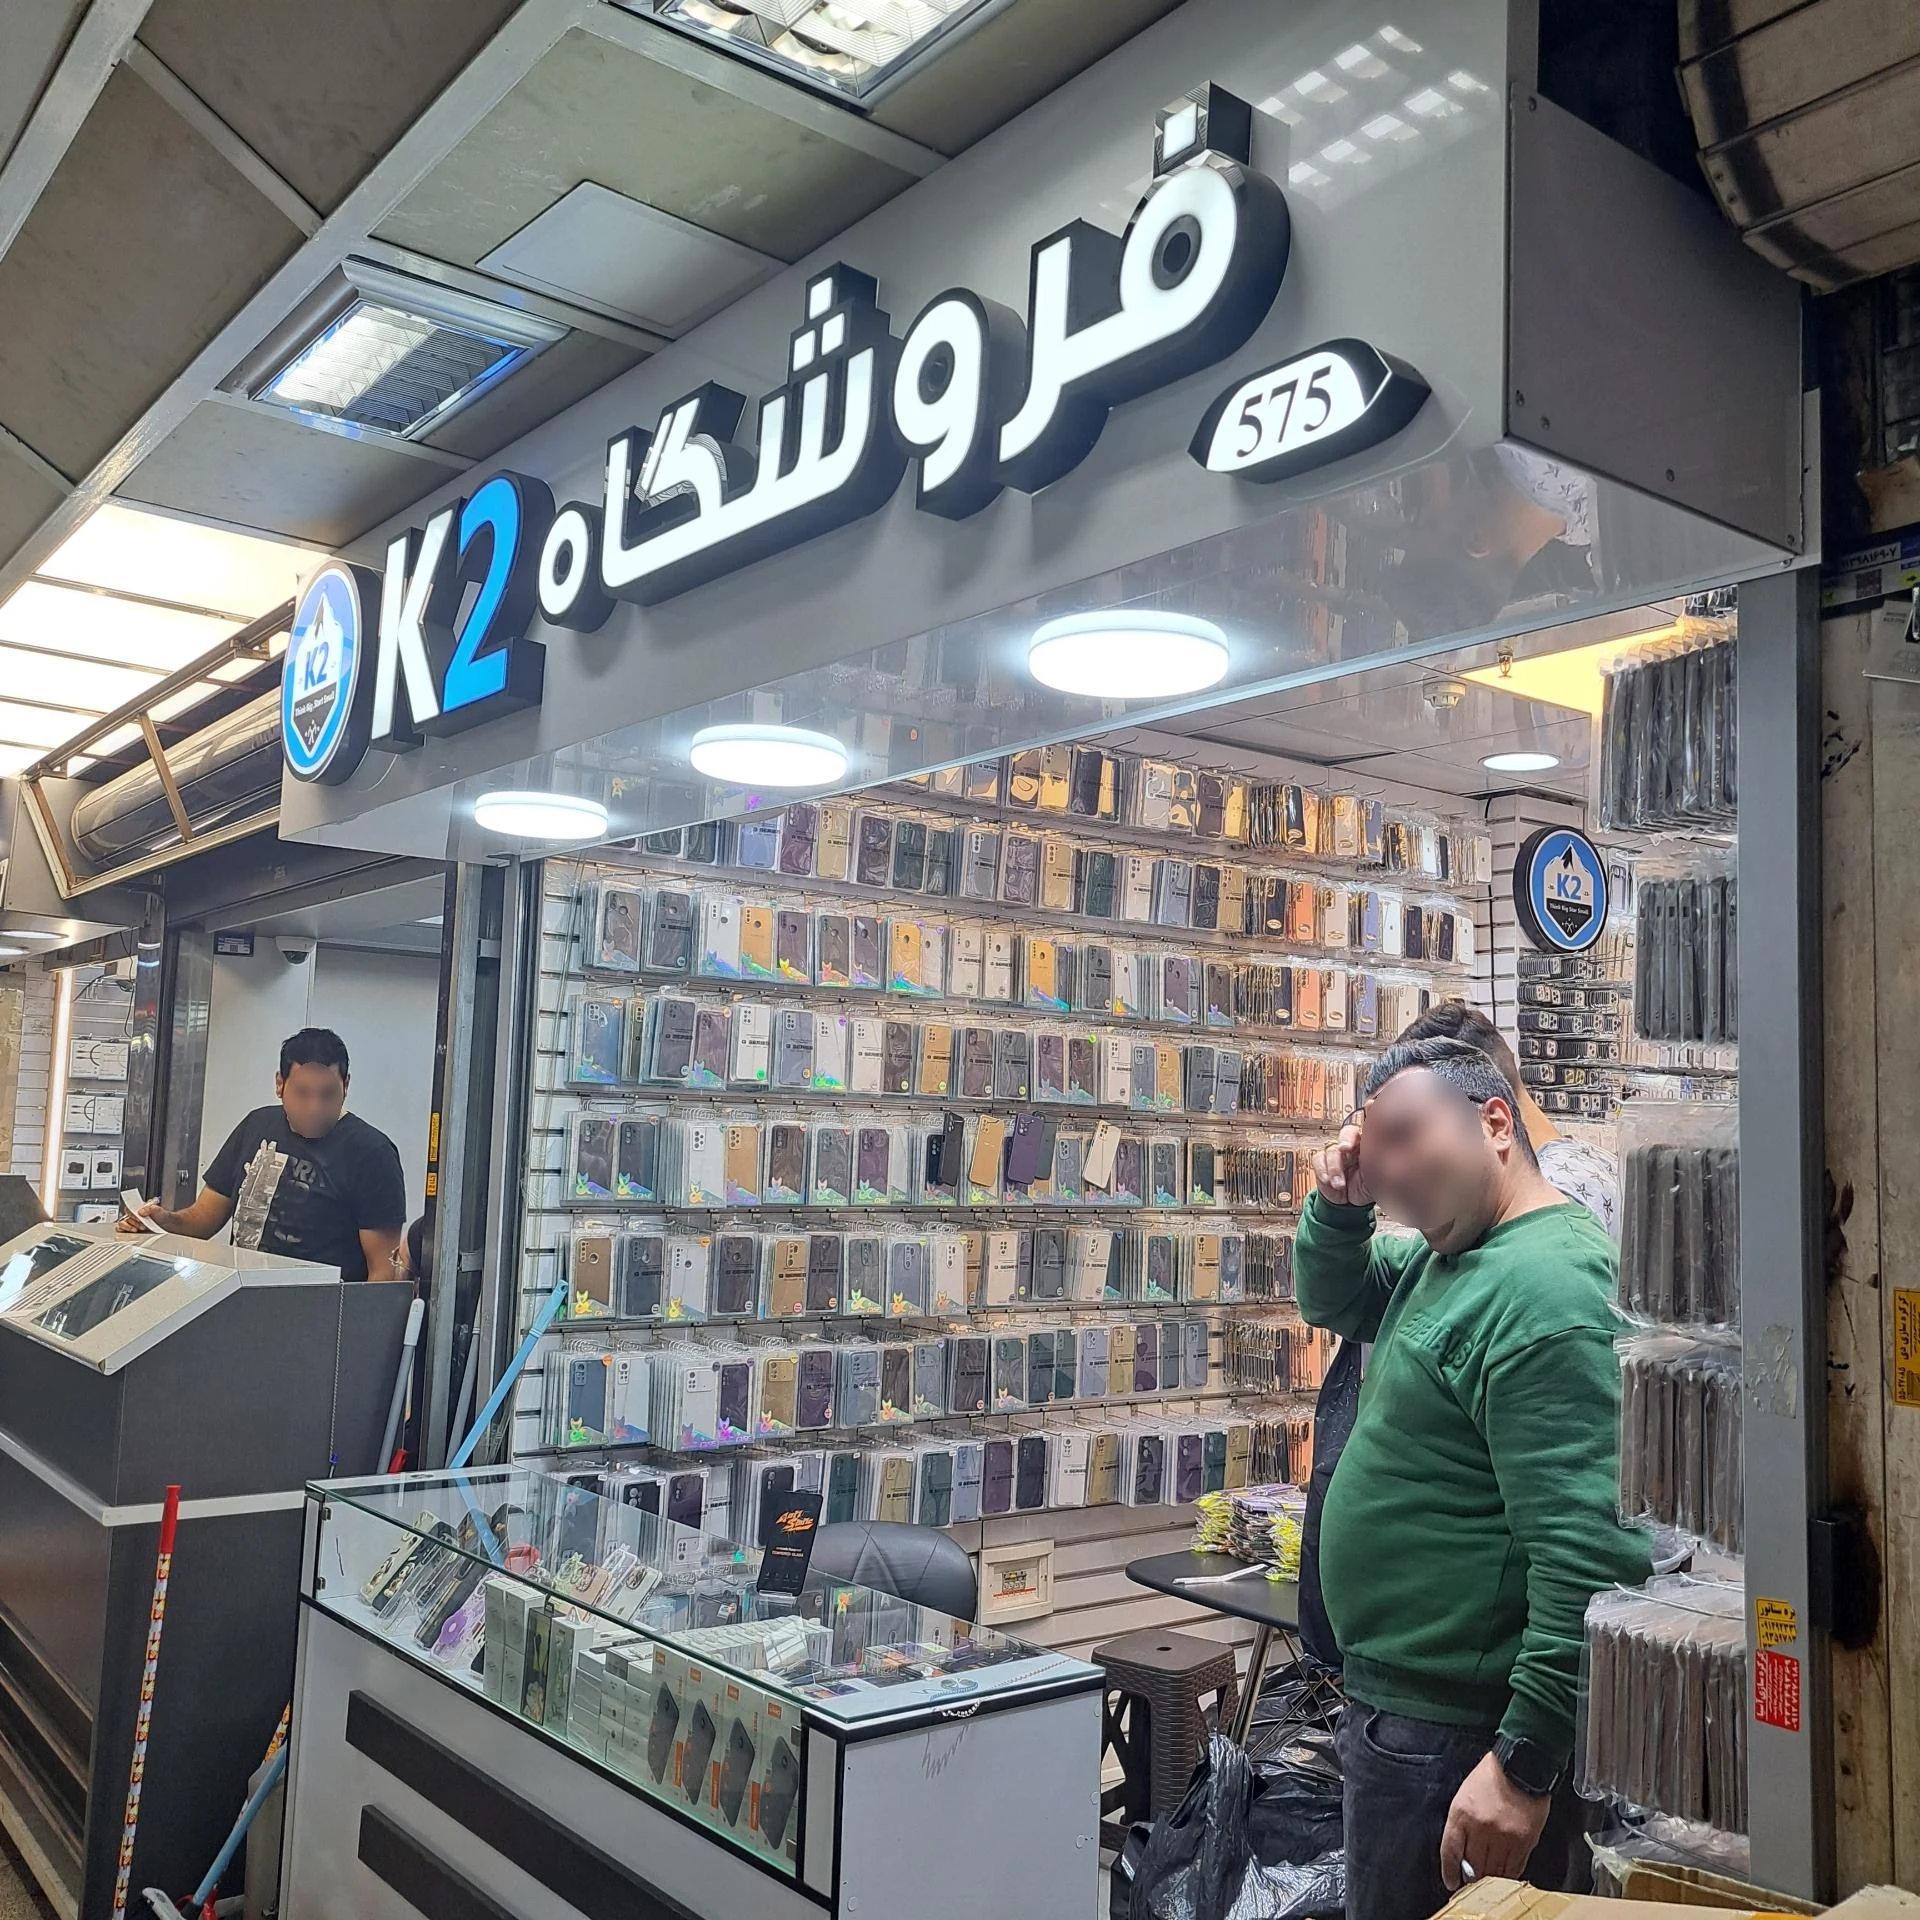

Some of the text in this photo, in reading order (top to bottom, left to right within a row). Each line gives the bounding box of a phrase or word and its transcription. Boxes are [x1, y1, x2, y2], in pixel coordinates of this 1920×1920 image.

[371, 102, 1238, 740] فروشگاه K2
[1235, 364, 1333, 458] 575
[304, 641, 330, 691] K2
[1557, 872, 1582, 900] K2
